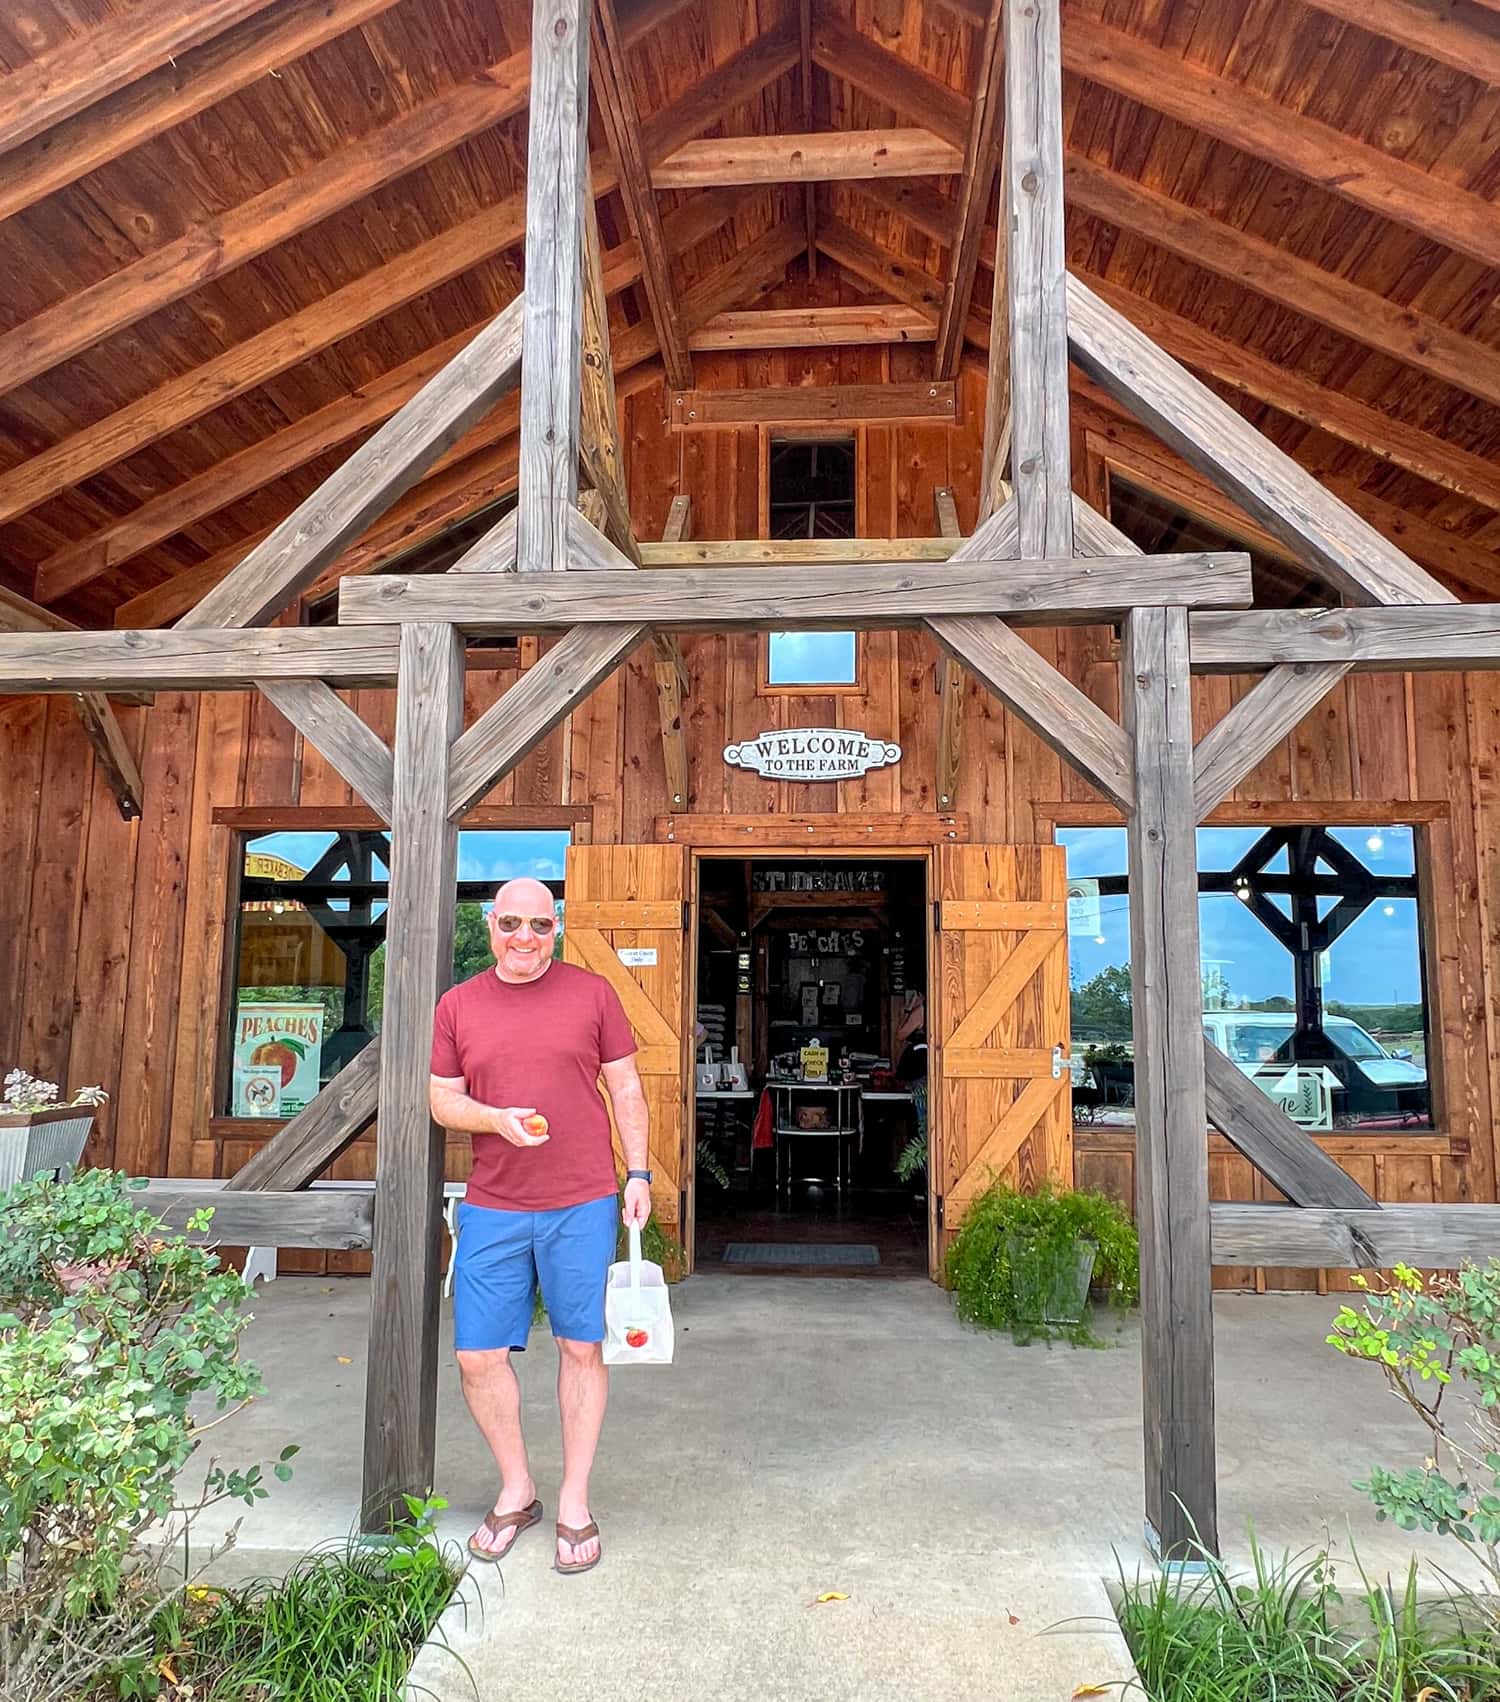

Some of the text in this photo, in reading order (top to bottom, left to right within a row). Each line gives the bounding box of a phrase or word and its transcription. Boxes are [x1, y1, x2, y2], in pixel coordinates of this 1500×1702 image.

[754, 737, 871, 759] WELCOME
[765, 759, 859, 771] TO THE FARM
[241, 1017, 318, 1045] PEACHES
